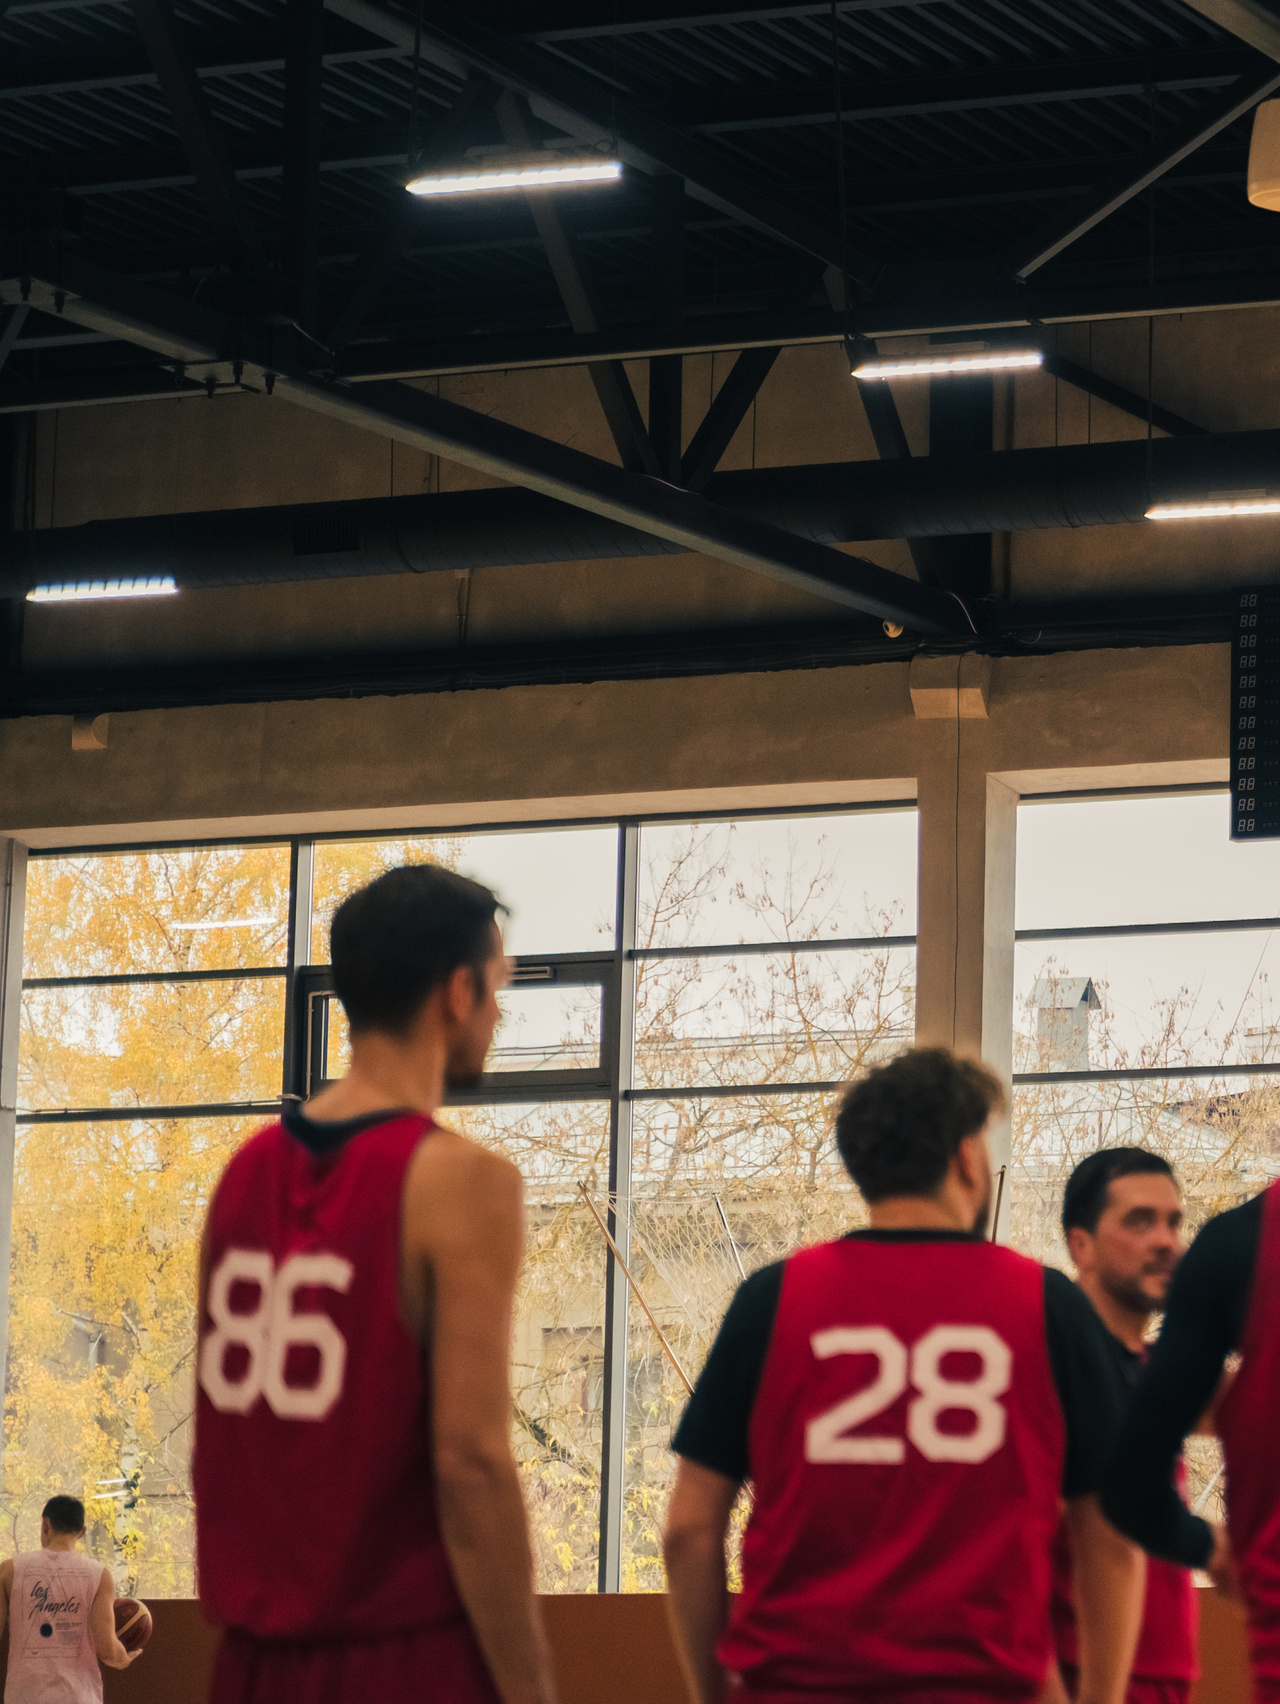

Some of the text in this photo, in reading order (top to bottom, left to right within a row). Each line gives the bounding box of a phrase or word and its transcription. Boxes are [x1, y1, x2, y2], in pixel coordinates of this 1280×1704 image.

[201, 1250, 353, 1421] 86
[806, 1325, 1013, 1465] 28
[28, 1597, 80, 1619] Angeles
